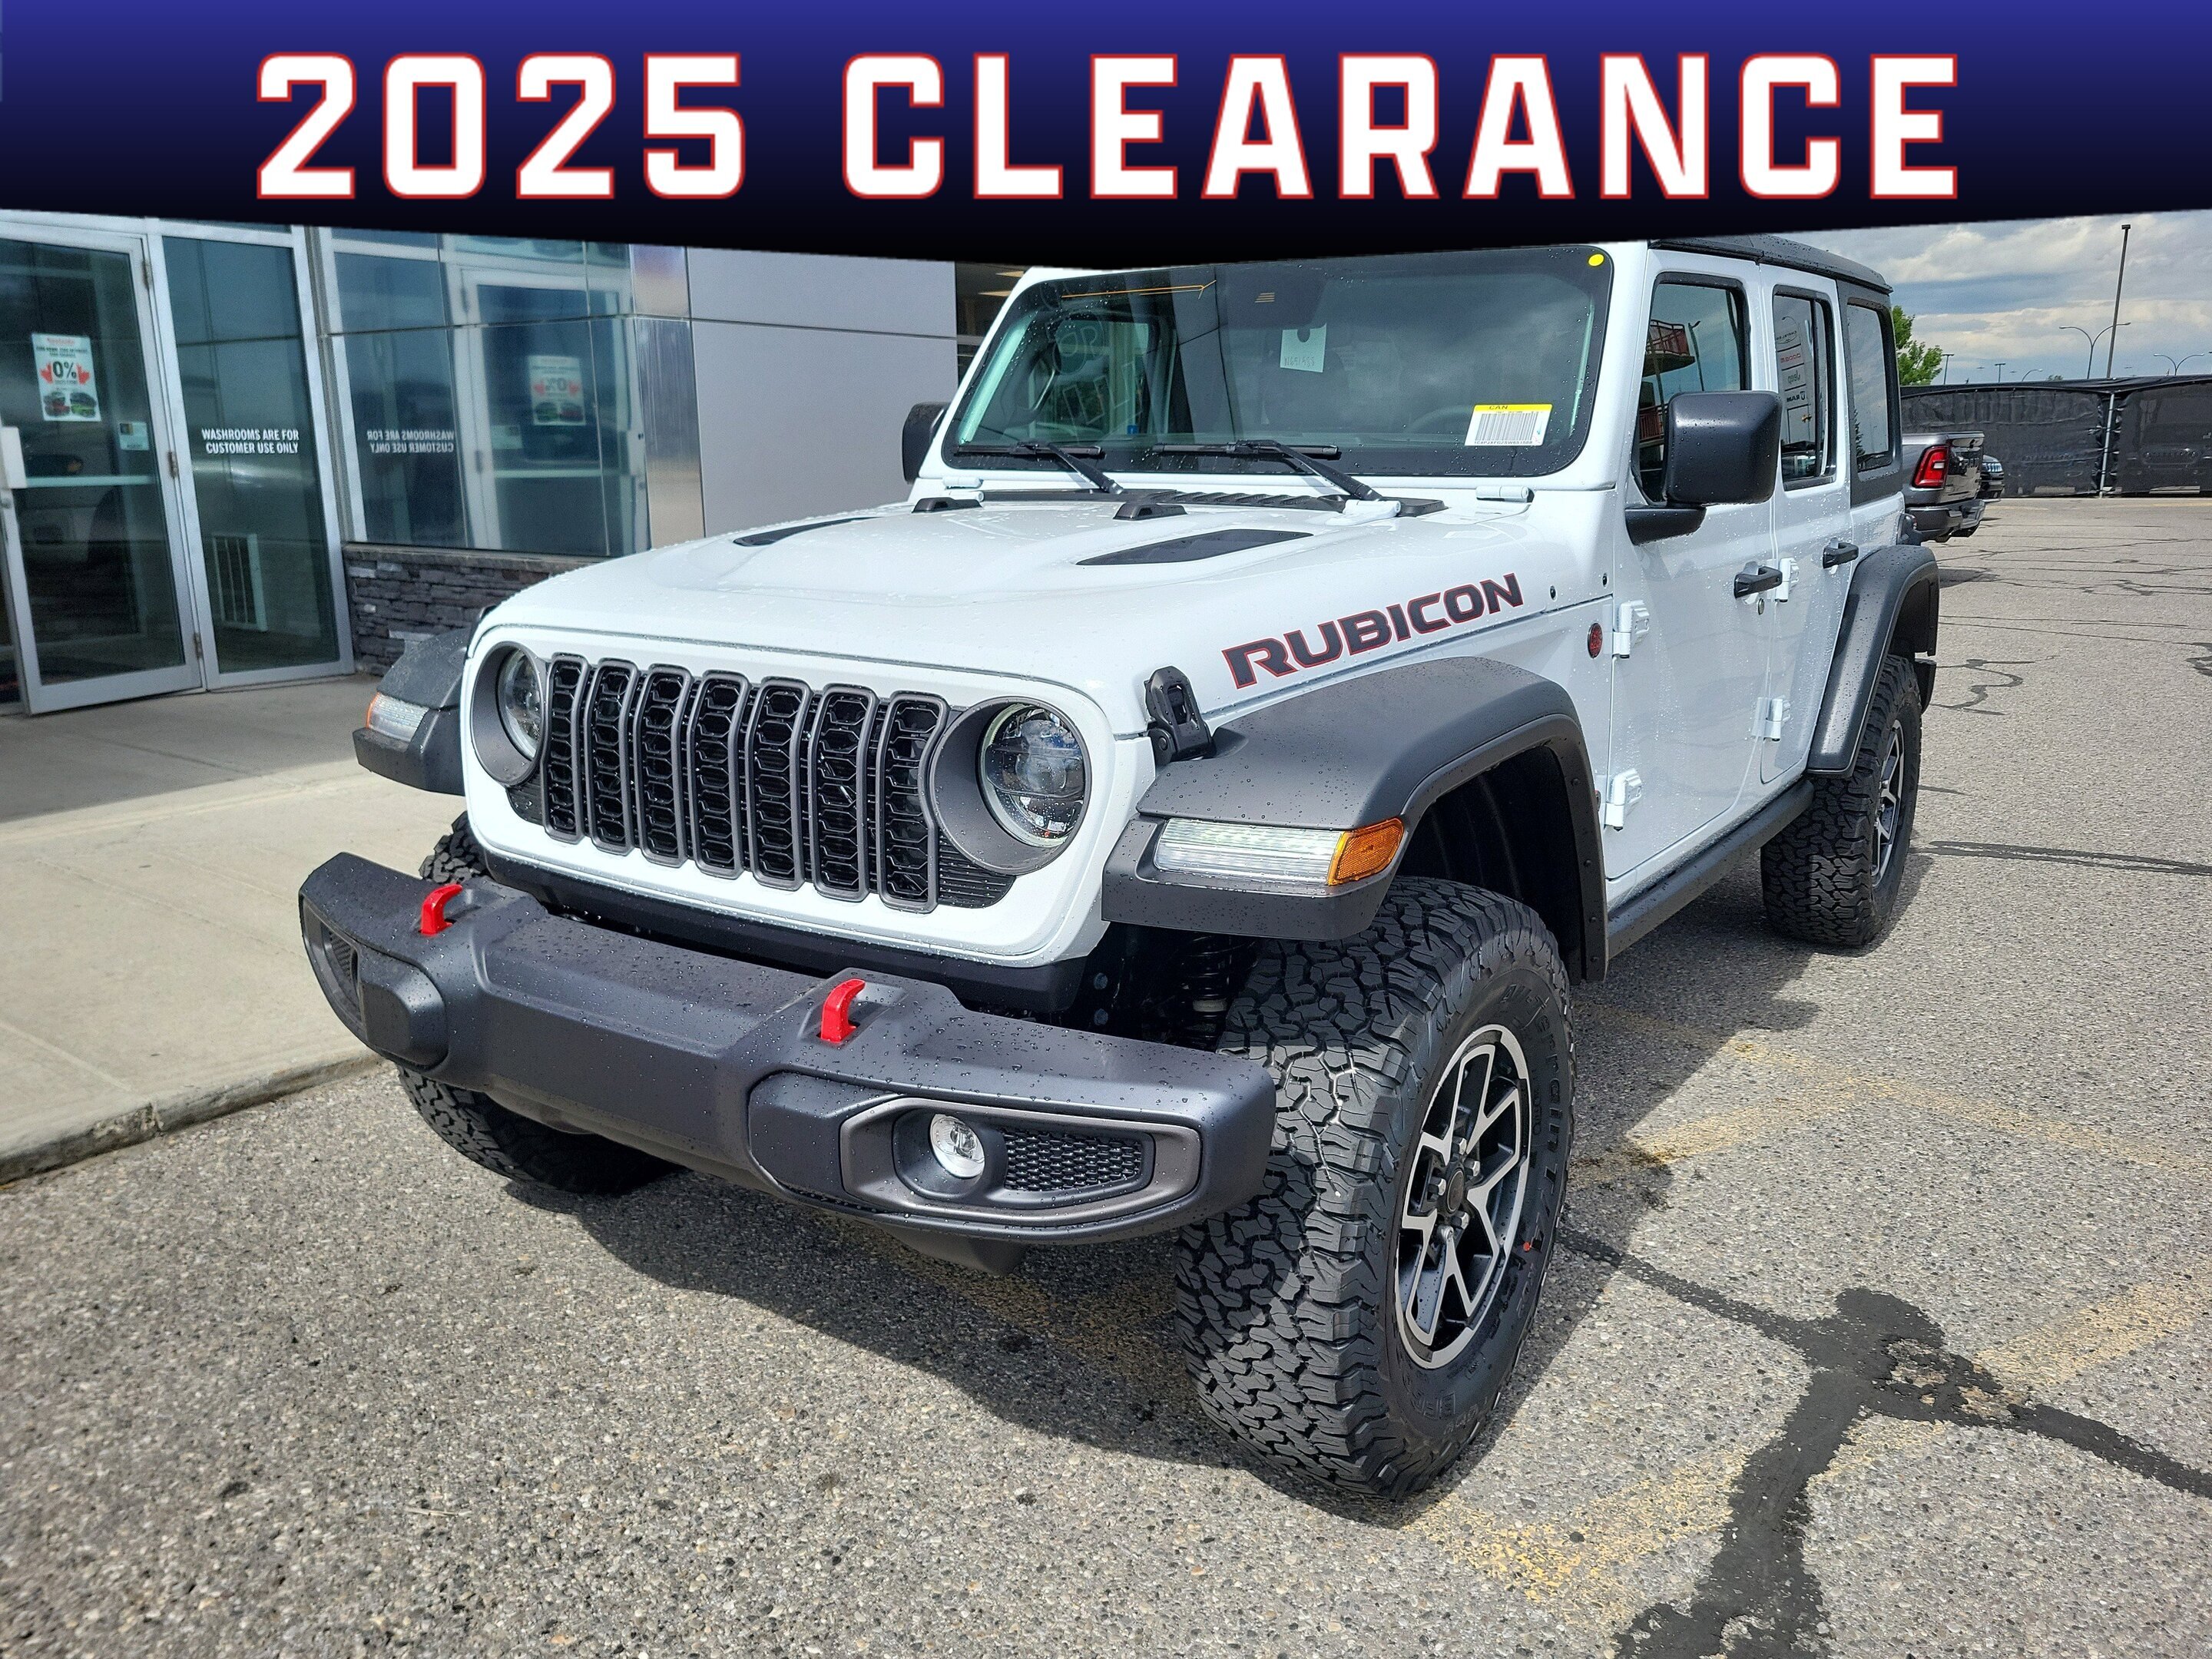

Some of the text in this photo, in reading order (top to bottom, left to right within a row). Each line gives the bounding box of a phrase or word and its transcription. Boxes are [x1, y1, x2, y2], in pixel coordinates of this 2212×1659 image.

[53, 361, 77, 379] 0%
[202, 428, 299, 440] WASHROOMS ARE FOR
[206, 442, 298, 453] CUSTOMER USE ONLY
[1221, 572, 1524, 690] RUBICON
